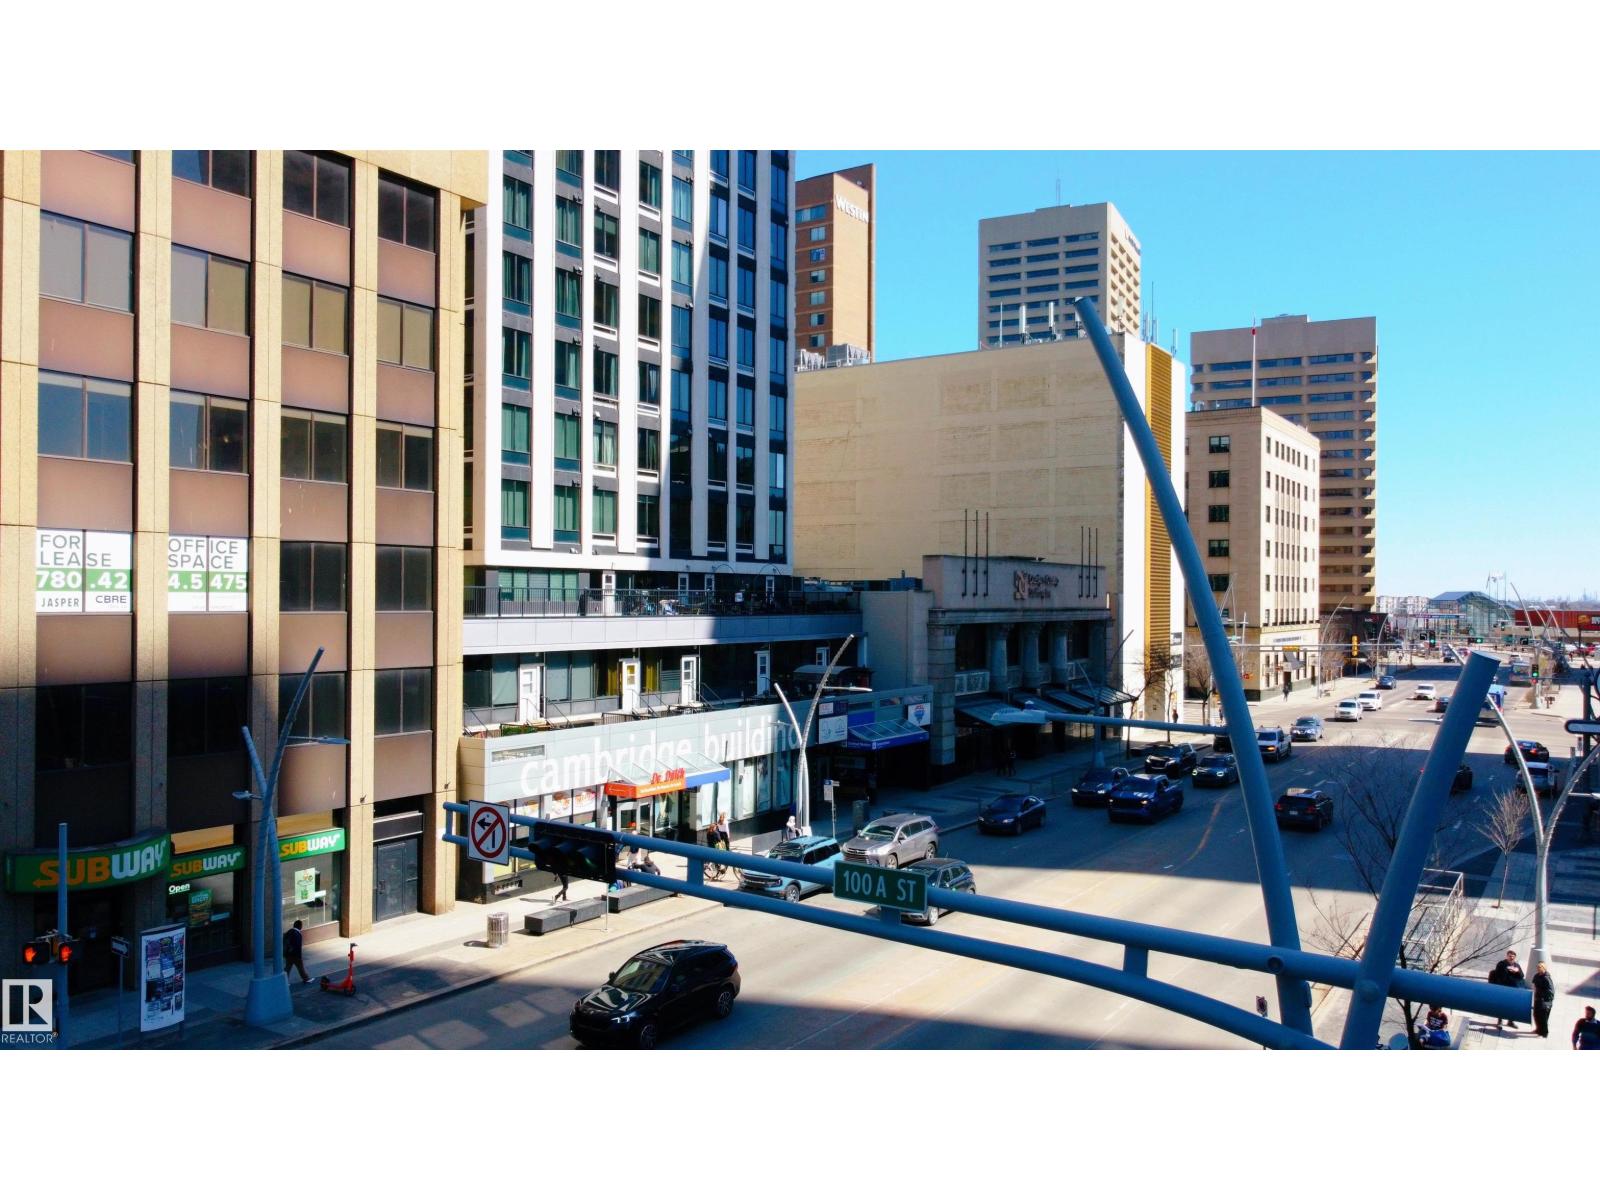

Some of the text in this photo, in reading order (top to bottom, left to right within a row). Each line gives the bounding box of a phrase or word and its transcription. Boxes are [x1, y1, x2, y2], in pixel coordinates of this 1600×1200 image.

[40, 534, 81, 550] FOR
[168, 538, 239, 554] OFFICE
[40, 551, 112, 567] LEASE
[168, 554, 234, 569] SPACE
[41, 597, 80, 608] JASPER
[95, 595, 127, 604] CBRE
[521, 729, 693, 797] cambridge
[280, 833, 341, 857] SUBWAY
[33, 839, 167, 887] SUBWAY
[170, 851, 242, 877] SUBWAY
[168, 883, 190, 894] Open
[897, 878, 917, 903] ST
